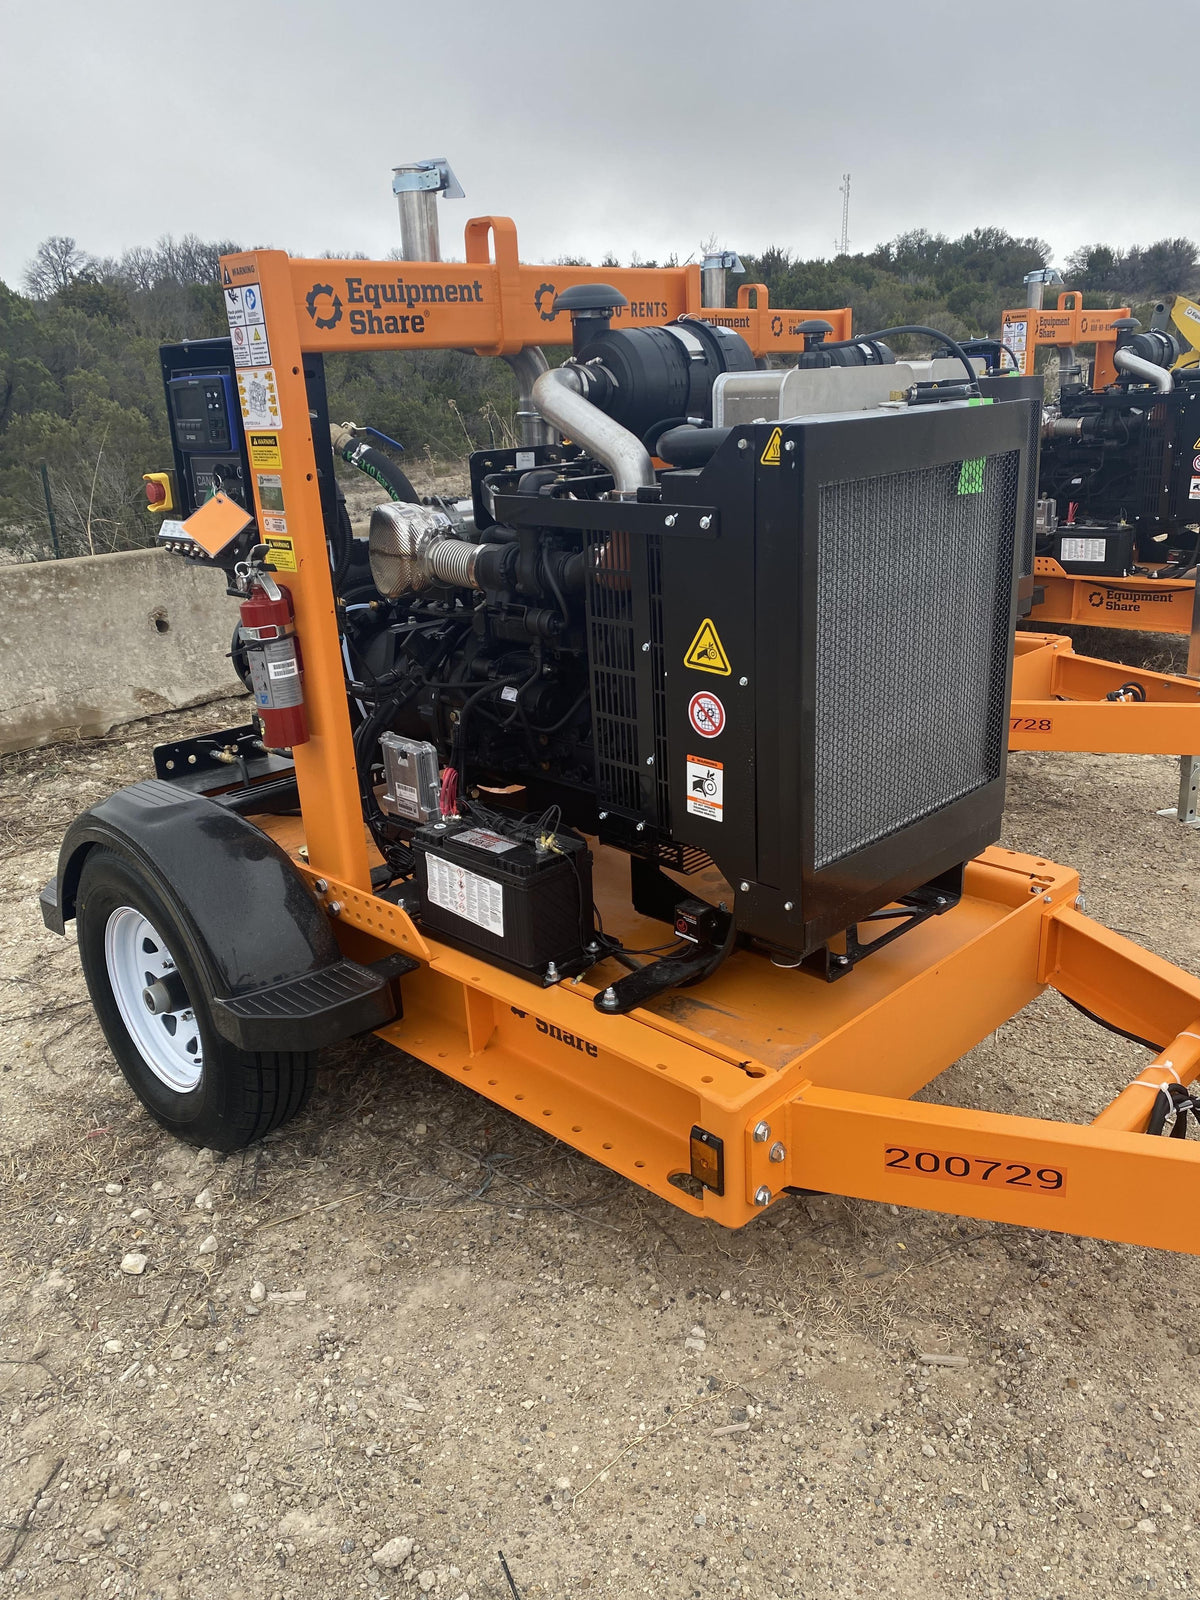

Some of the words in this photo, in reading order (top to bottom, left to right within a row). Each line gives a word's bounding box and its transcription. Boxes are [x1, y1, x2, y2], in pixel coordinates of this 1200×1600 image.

[232, 265, 255, 276] WARNING
[345, 278, 483, 309] Equipment
[1040, 316, 1070, 328] Equipment
[1039, 329, 1056, 338] Share
[257, 438, 276, 446] WARNING
[1106, 591, 1173, 602] Equipment
[1105, 601, 1141, 612] Share
[1010, 718, 1051, 731] 728
[885, 1148, 1064, 1190] 200729
